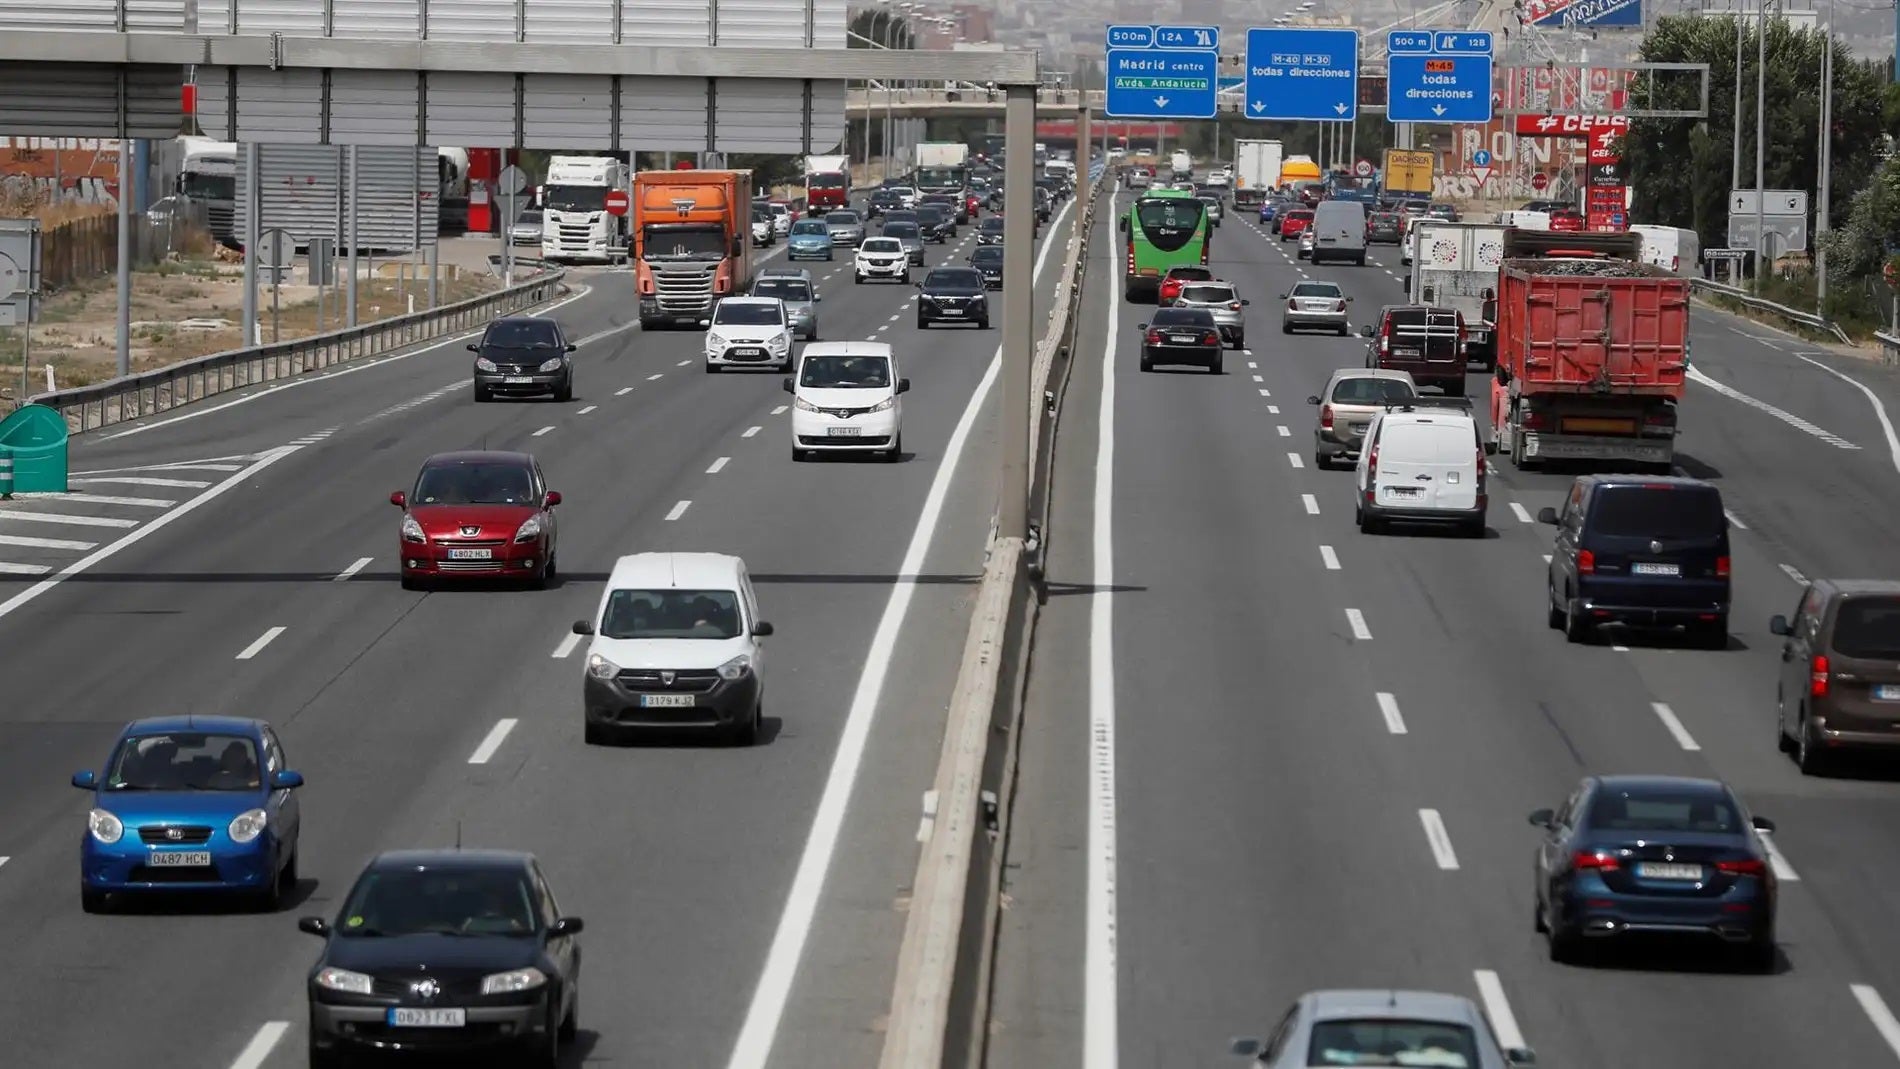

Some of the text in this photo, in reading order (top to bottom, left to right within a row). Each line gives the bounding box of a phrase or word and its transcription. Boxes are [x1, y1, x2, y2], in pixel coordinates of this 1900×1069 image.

[1113, 31, 1147, 41] 500m
[1161, 32, 1183, 42] 12A
[1394, 37, 1414, 46] 500
[1469, 39, 1486, 47] 12B
[1119, 59, 1204, 71] Madrid centro
[1304, 56, 1329, 64] M-30
[1426, 61, 1453, 70] M-45
[1252, 66, 1351, 78] todas direcciones
[1117, 78, 1146, 88] Avda.
[1422, 74, 1457, 84] todas
[1406, 88, 1473, 99] direcciones
[453, 550, 473, 558] 4802
[648, 696, 672, 705] 3179
[153, 853, 208, 864] 0487 HCH
